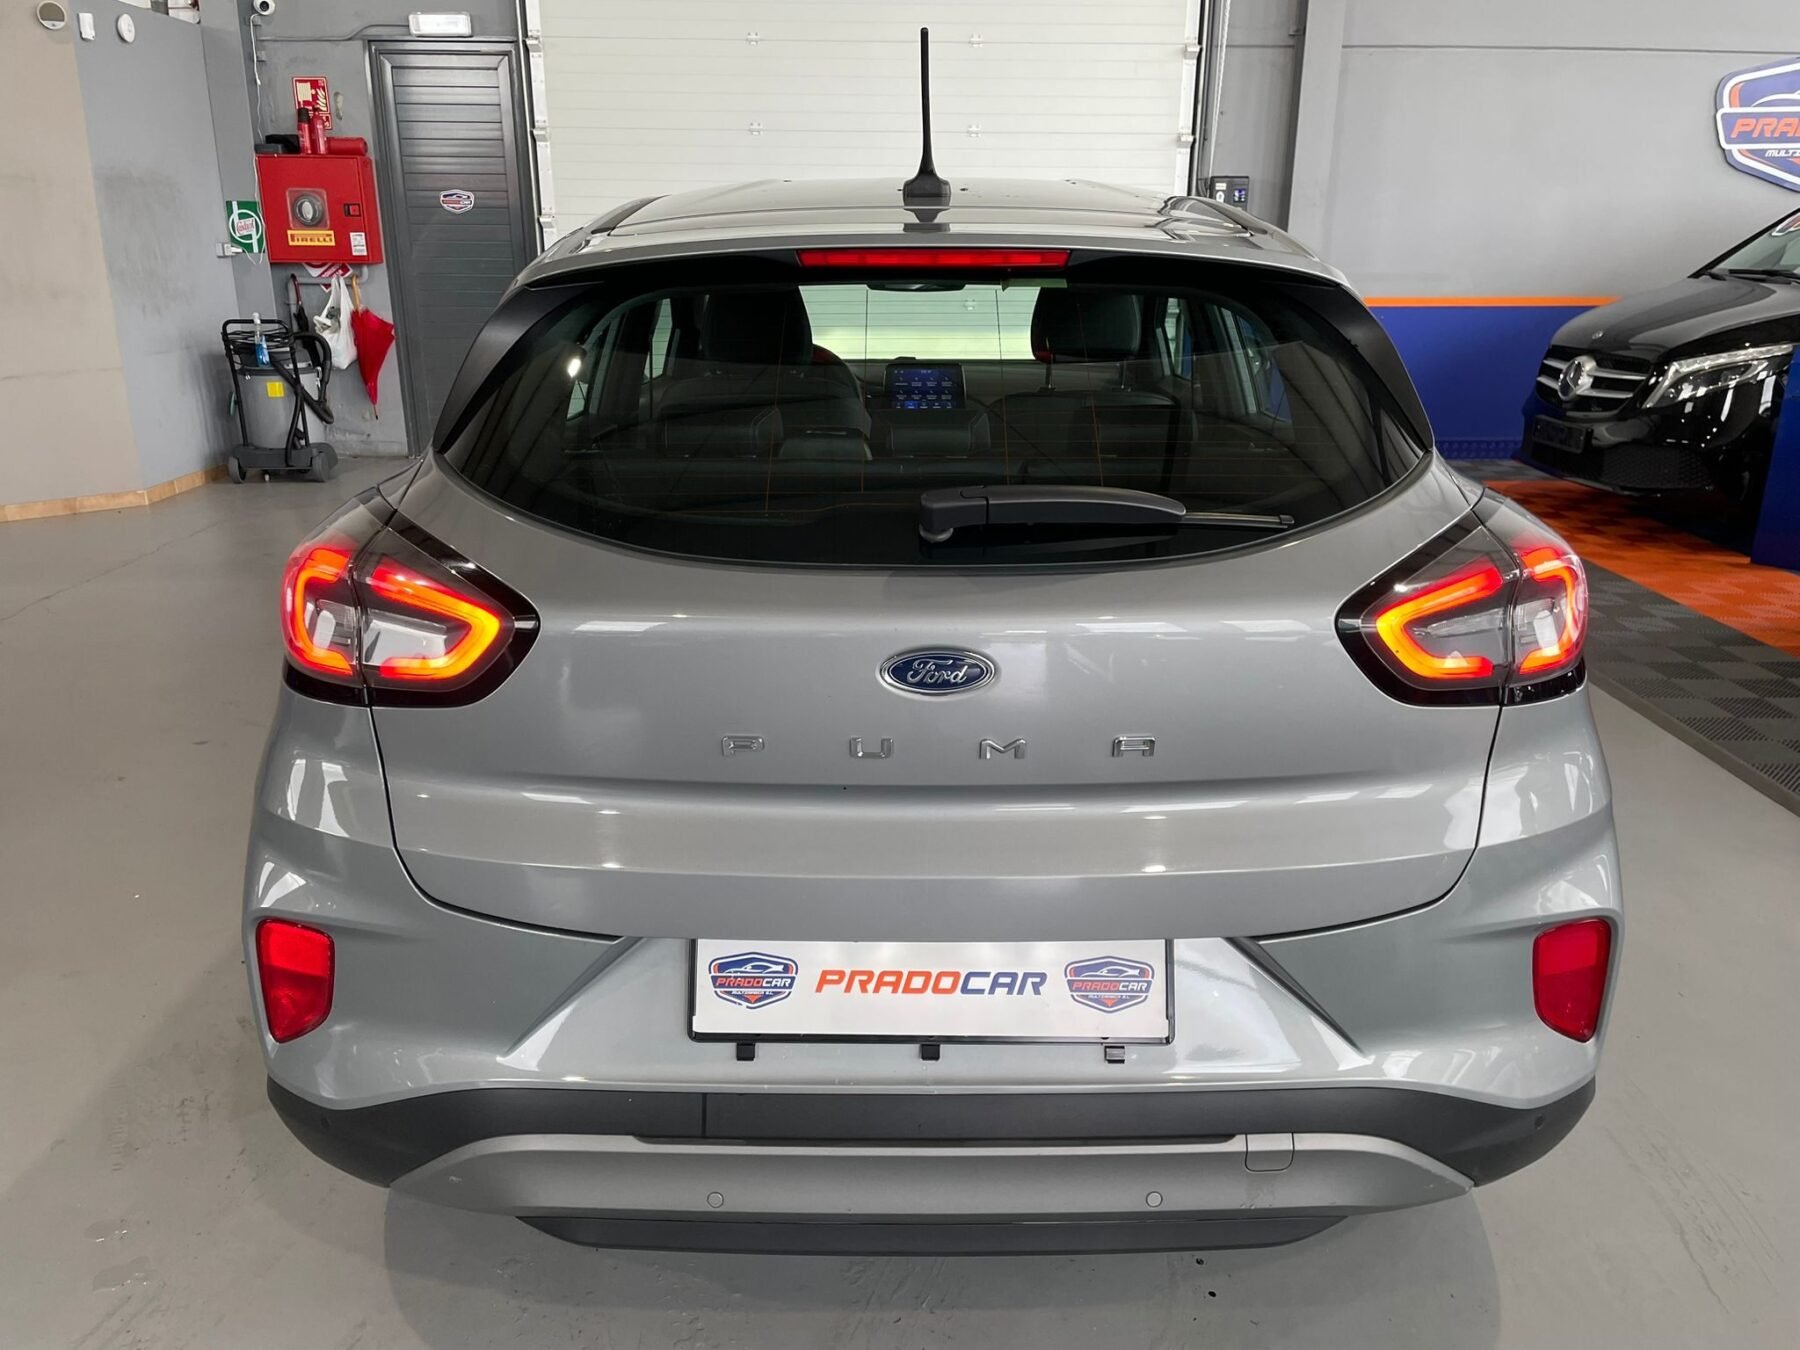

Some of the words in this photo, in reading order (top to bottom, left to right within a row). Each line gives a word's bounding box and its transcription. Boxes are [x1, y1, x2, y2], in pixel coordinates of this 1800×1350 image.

[1730, 117, 1800, 138] PRA
[290, 234, 333, 243] PIRELLI
[906, 658, 968, 684] Ford
[716, 977, 791, 987] PRADOCAR
[815, 969, 1048, 996] PRADOCAR
[1072, 981, 1147, 991] PRADOCAR
